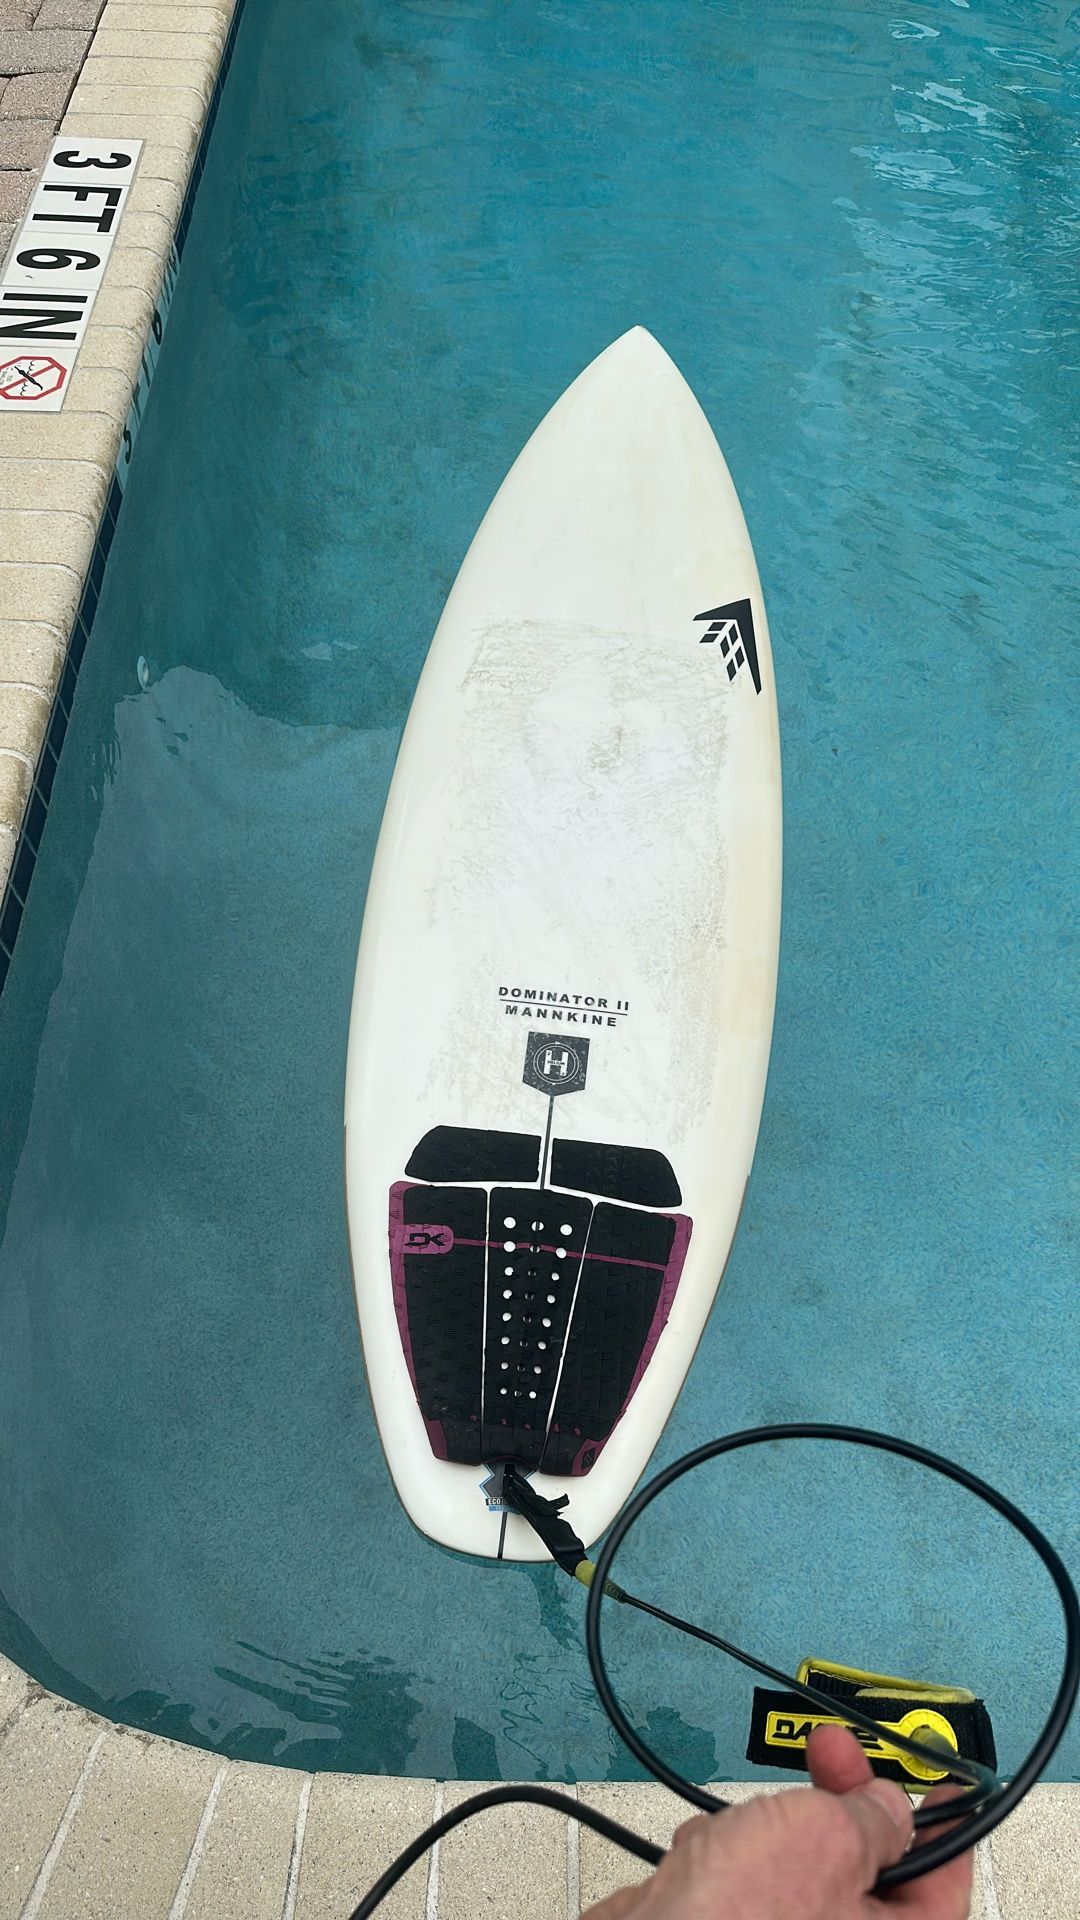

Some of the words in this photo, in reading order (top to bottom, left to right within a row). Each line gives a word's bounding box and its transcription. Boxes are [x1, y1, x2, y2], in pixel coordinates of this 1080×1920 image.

[53, 150, 132, 170] 3
[32, 184, 123, 233] FT
[16, 248, 101, 271] 6
[0, 292, 89, 341] IN
[498, 986, 608, 1009] DOMINATOR
[617, 1000, 629, 1011] II
[505, 1005, 617, 1027] MANNKINE
[404, 1232, 446, 1247] DK
